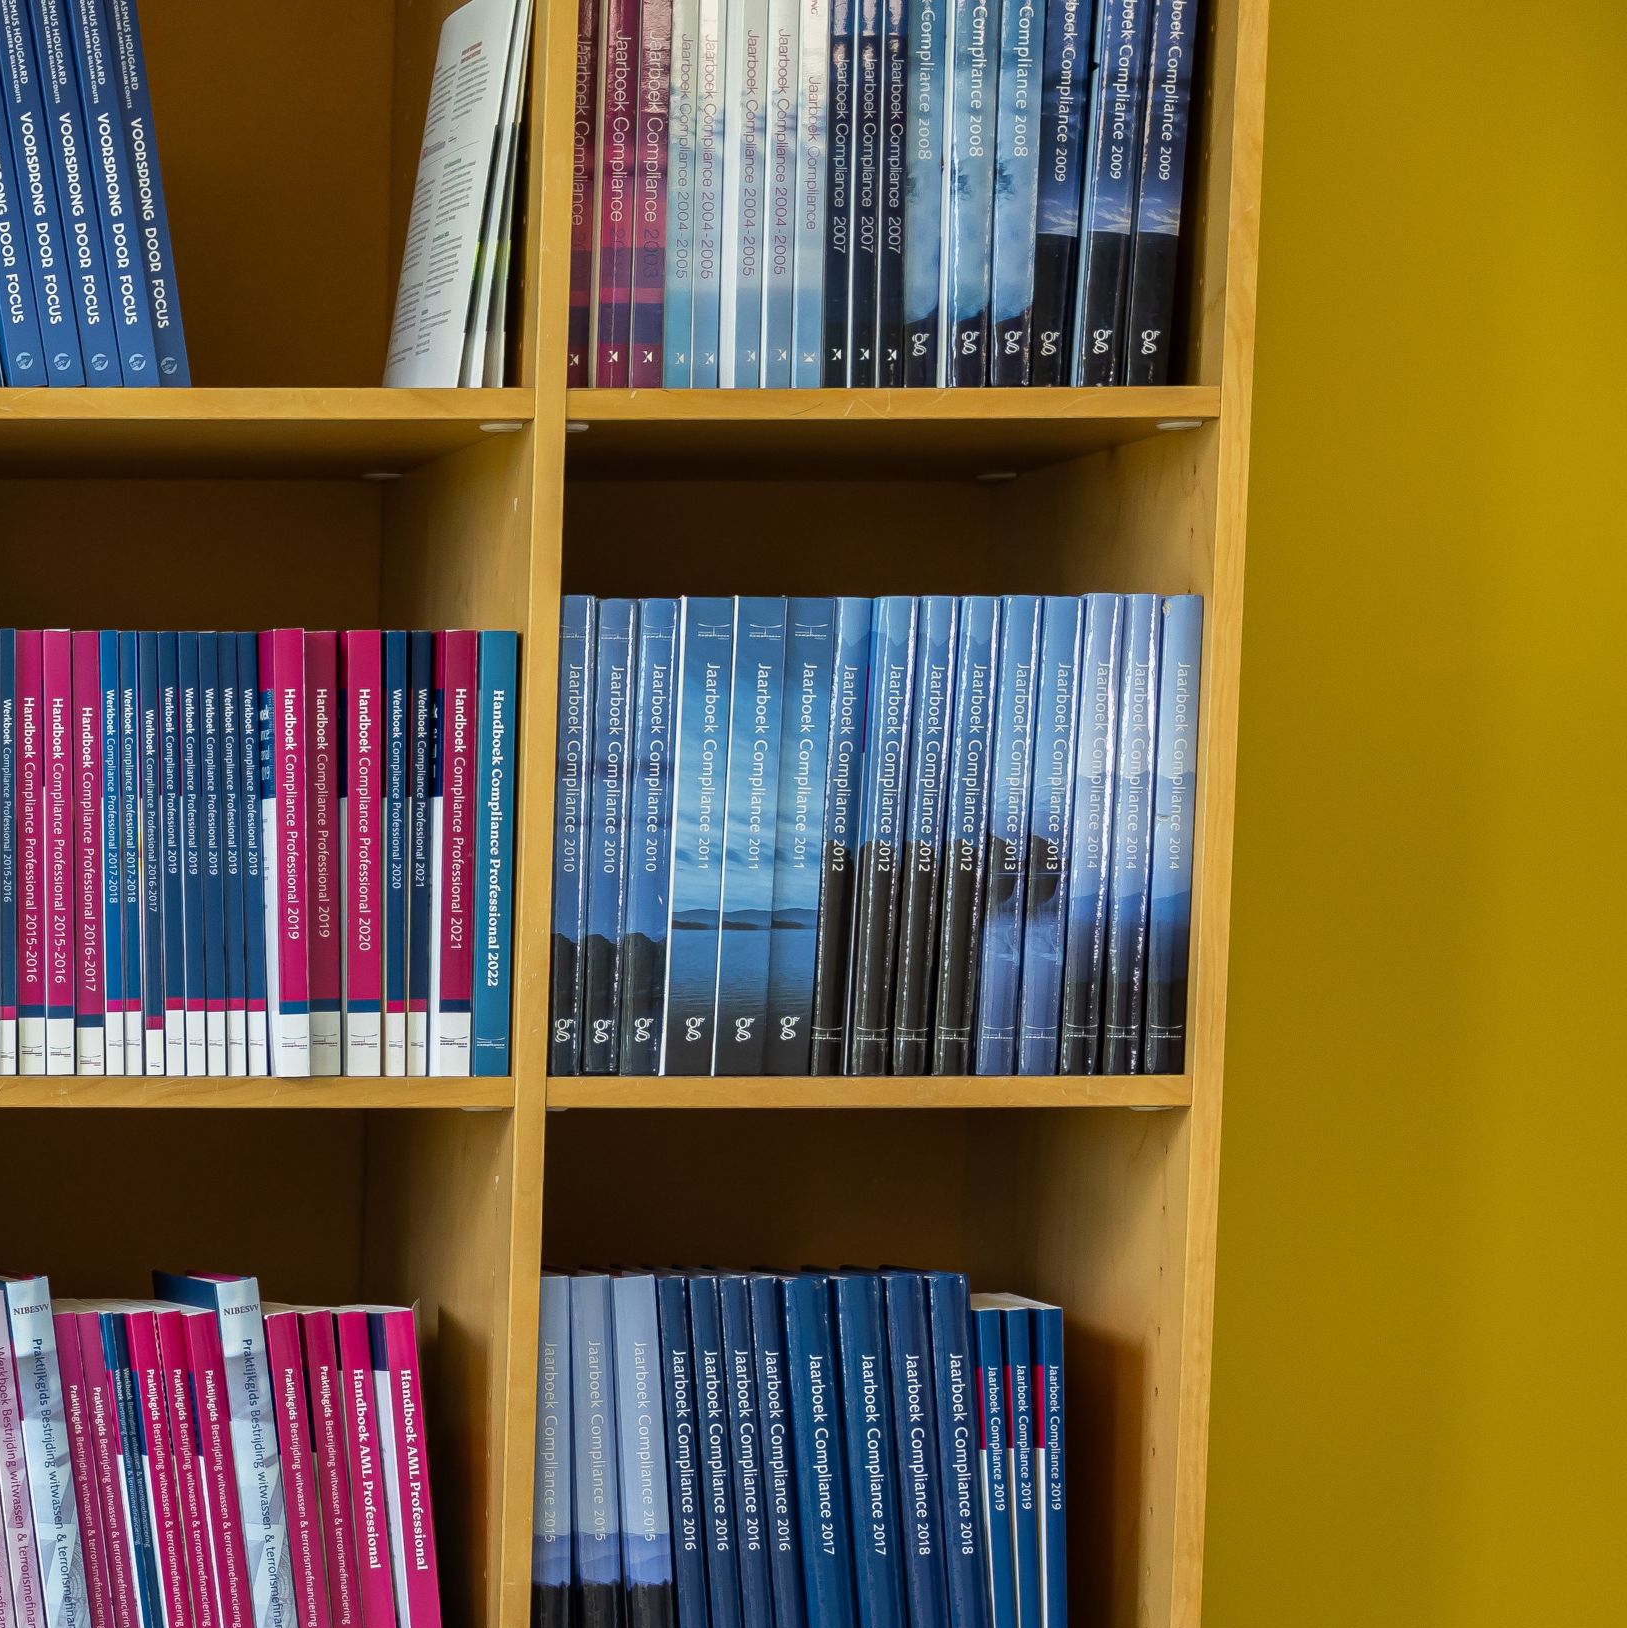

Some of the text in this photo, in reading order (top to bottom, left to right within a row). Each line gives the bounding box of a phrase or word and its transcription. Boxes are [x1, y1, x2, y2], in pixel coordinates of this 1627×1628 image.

[1158, 47, 1182, 180] Compliance 2009
[6, 273, 25, 323] FOCUS
[487, 690, 504, 987] Handboek Compliance Professional 2022
[698, 662, 720, 869] Jaarboek Compliance 2011
[401, 1369, 429, 1570] Handboek AML Professional
[809, 1355, 835, 1555] Jaarboek Compliance 2017
